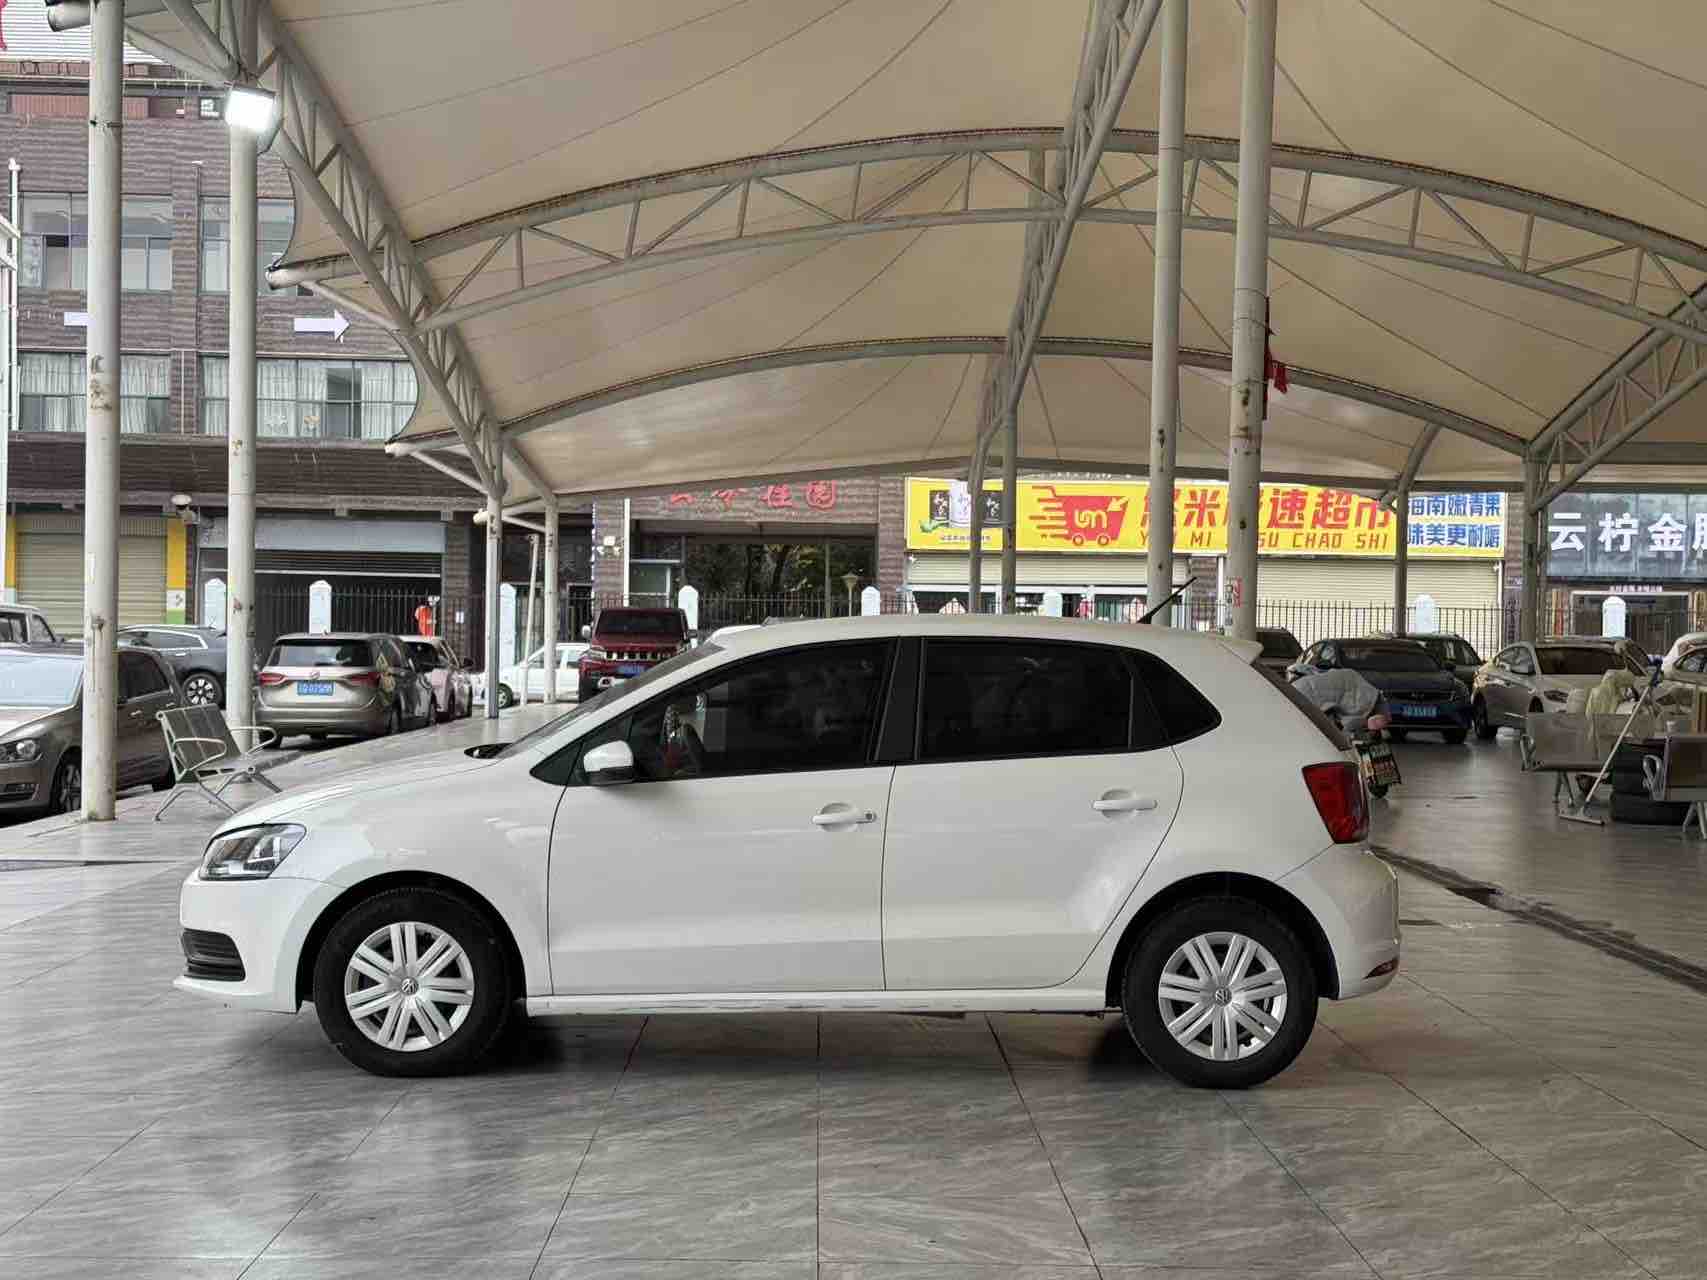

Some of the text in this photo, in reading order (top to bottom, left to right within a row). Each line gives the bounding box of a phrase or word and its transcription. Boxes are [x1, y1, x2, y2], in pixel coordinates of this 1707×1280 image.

[1140, 488, 1390, 530] 米速超市
[1190, 531, 1212, 547] MI
[1292, 532, 1344, 549] CHAO
[1355, 533, 1390, 550] SHI
